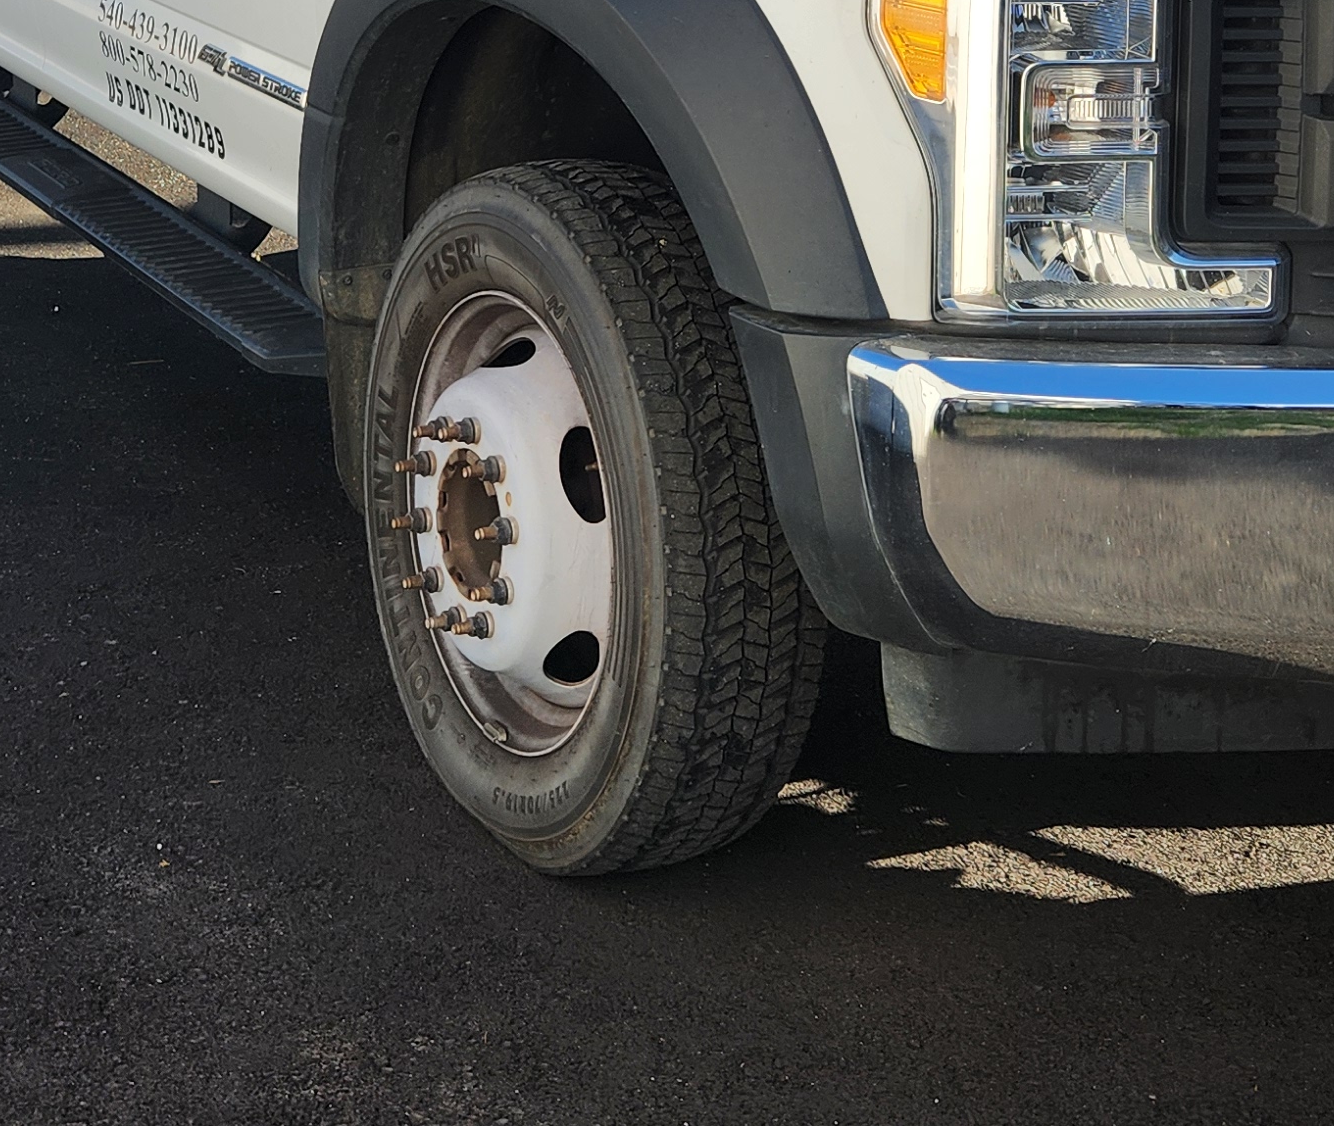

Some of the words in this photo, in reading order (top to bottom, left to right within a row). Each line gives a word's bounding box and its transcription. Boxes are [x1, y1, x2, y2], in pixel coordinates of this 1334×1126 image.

[99, 30, 199, 103] 800-578-2230
[228, 60, 262, 85] POWER
[261, 77, 303, 104] STROKE
[105, 71, 124, 108] US
[125, 78, 152, 120] DOT
[154, 93, 226, 160] 11331289
[373, 384, 443, 732] CONTINENTAL
